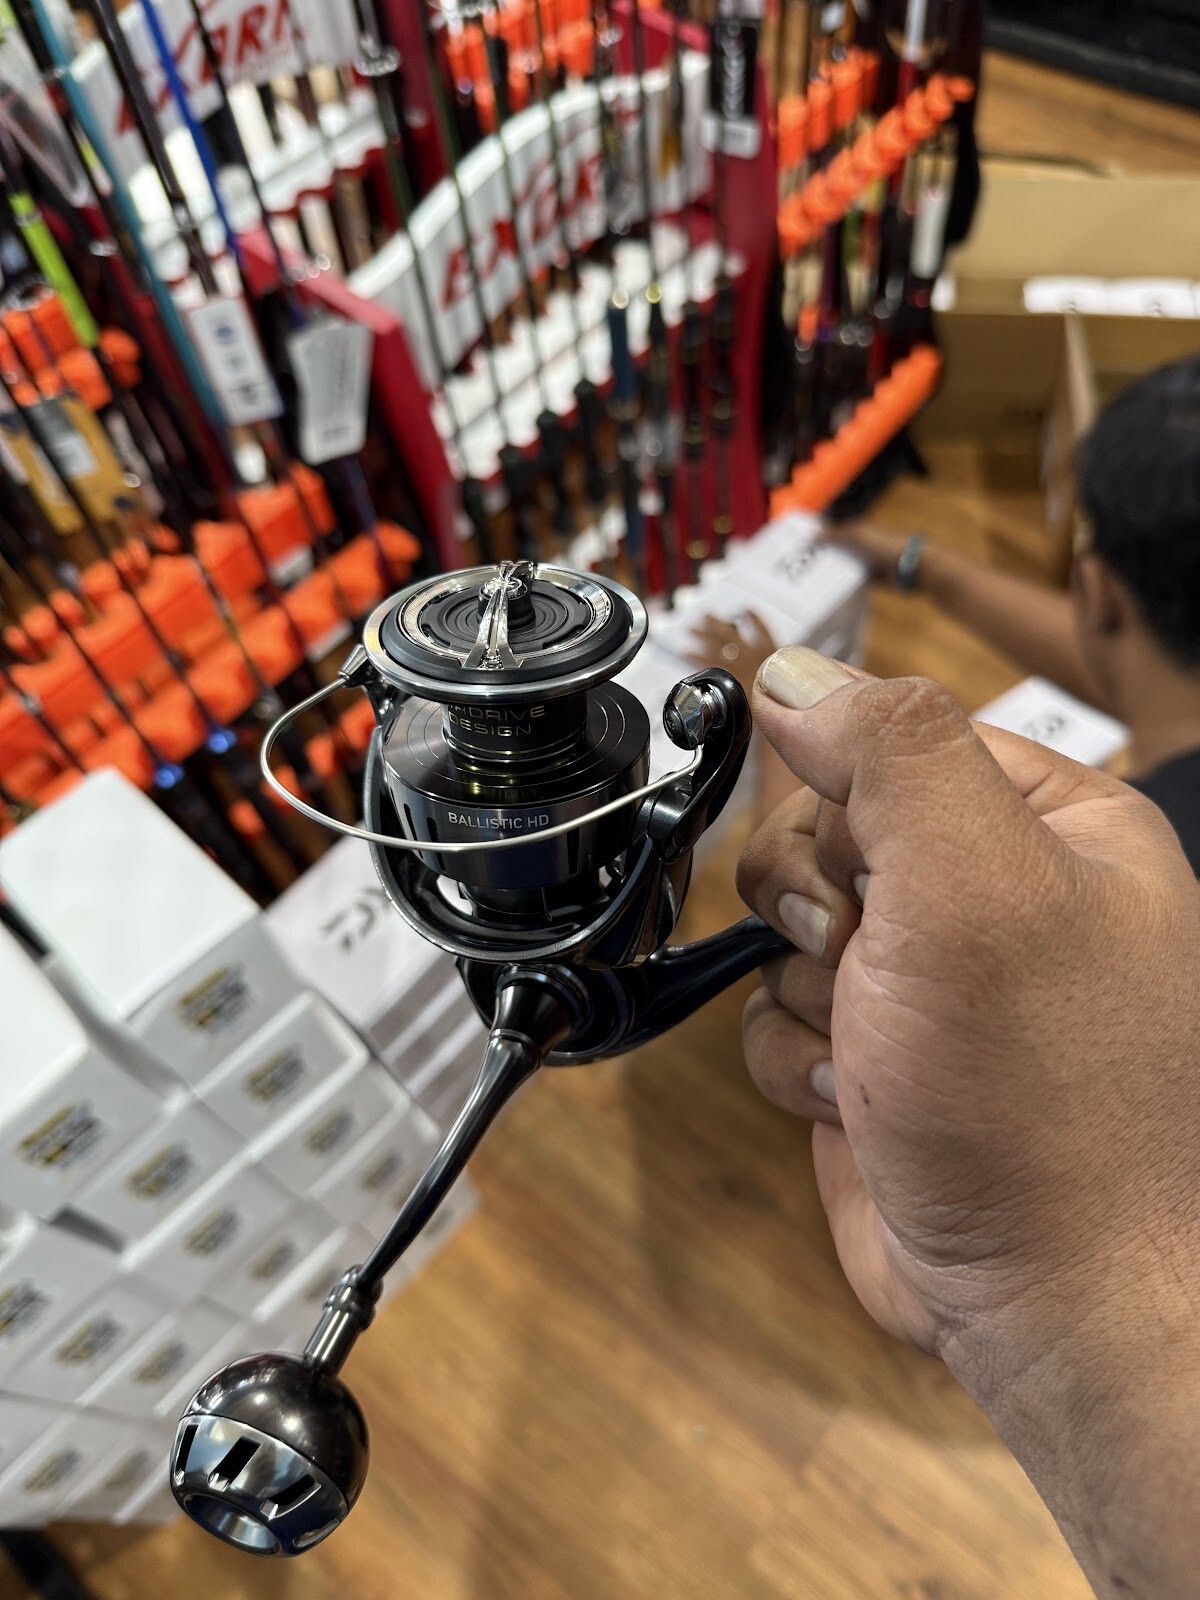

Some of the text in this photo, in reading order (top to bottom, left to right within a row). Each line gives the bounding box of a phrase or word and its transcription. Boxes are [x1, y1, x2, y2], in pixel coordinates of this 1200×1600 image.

[448, 710, 532, 737] DESIGN
[448, 811, 549, 830] BALLISTIC HD
